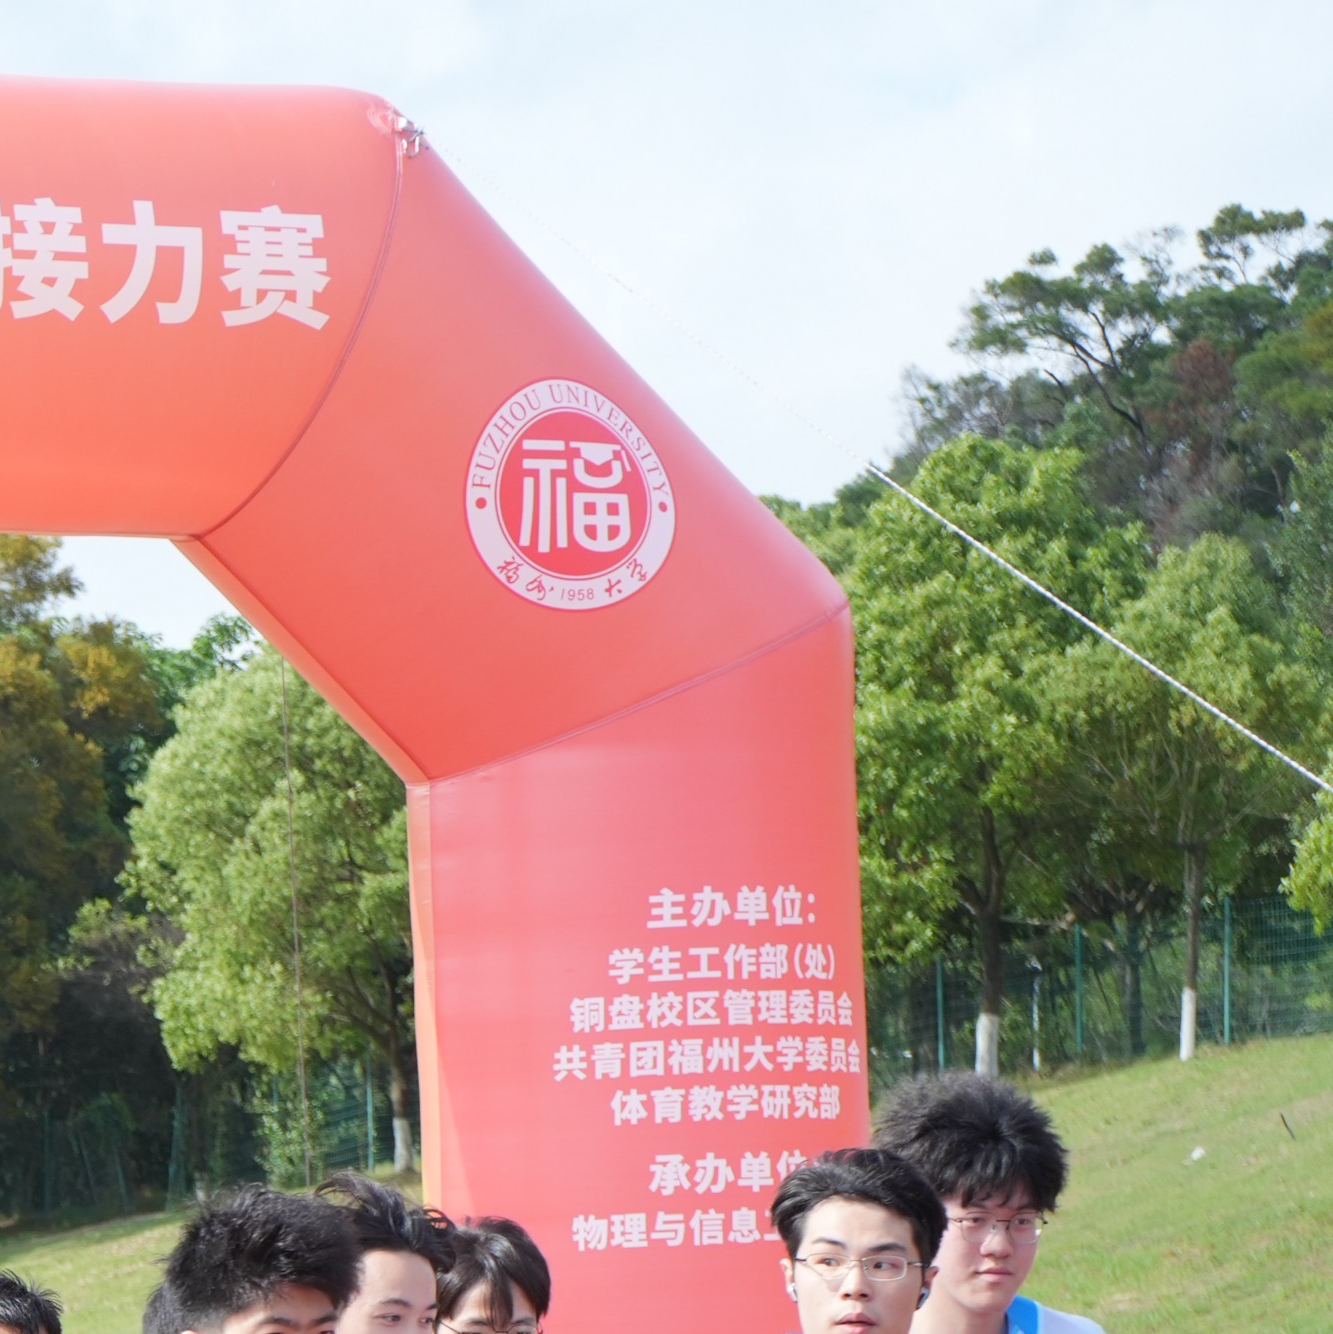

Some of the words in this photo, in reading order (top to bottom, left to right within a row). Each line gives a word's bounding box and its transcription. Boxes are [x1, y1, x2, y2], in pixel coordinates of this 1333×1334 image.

[471, 389, 542, 490] FUZHOU
[547, 383, 669, 496] UNIVERSITY
[560, 588, 595, 601] 1958
[569, 989, 853, 1033] 铜盘校区管理委员会
[552, 1035, 861, 1081] 共青团福州大学委员会
[610, 1083, 841, 1126] 体育教学研究部
